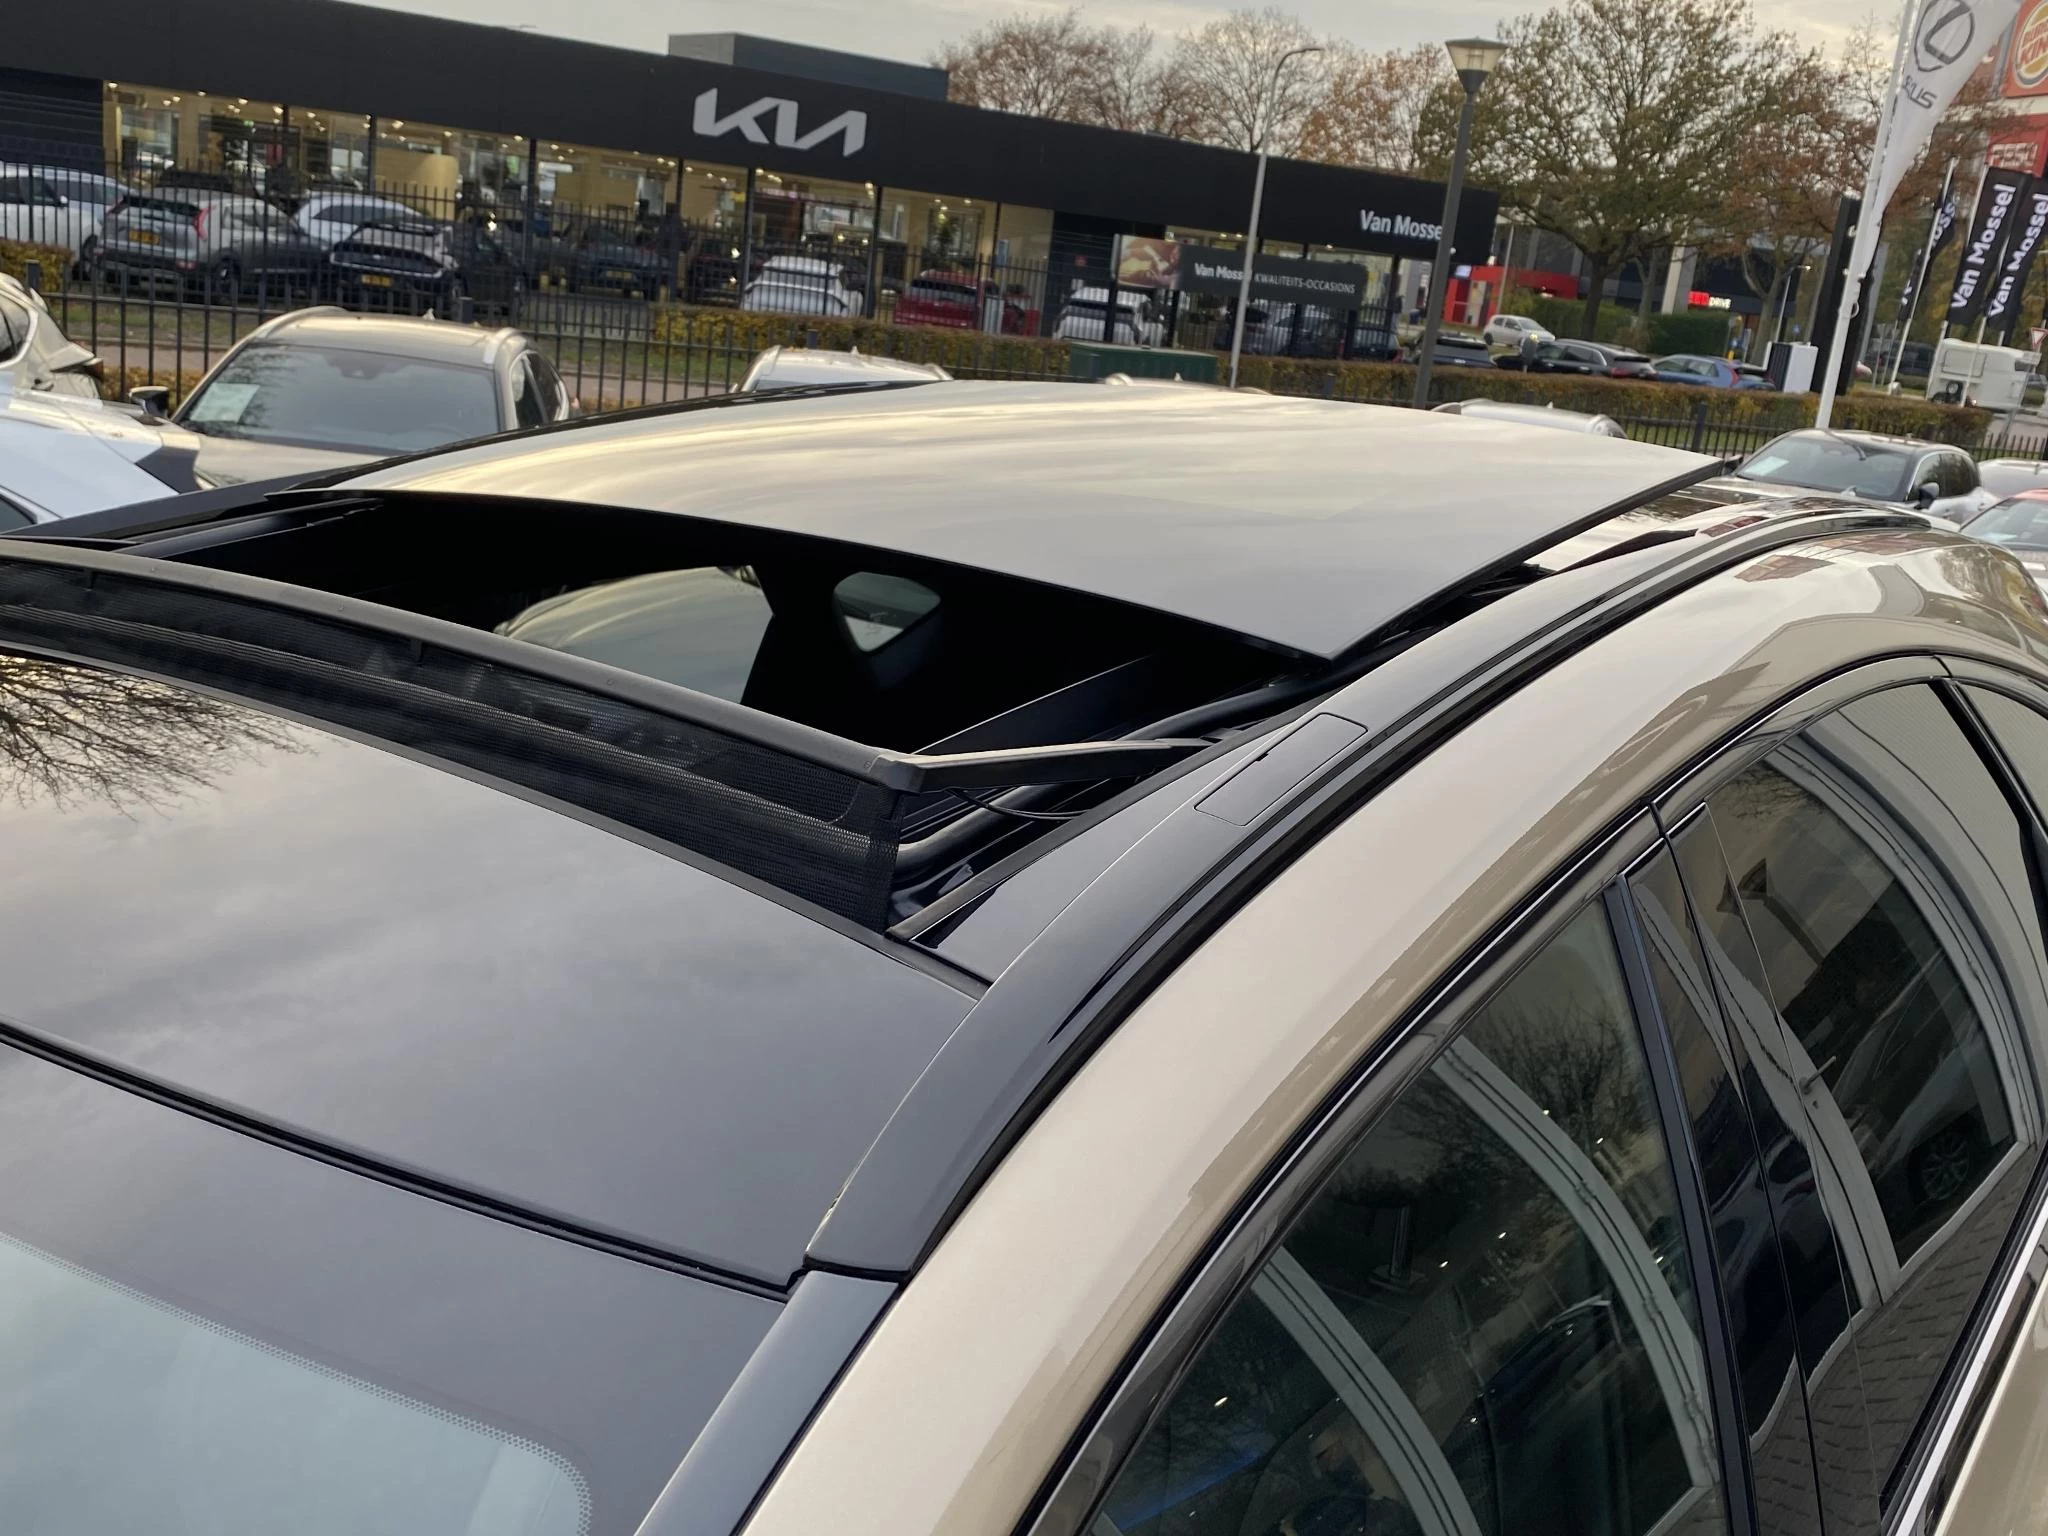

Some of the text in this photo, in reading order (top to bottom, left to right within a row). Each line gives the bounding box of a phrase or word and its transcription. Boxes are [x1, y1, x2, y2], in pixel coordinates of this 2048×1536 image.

[693, 87, 867, 156] KIA
[1360, 208, 1443, 240] Van Mosse
[1951, 269, 1980, 308] Van
[1967, 184, 2016, 265] Mossel
[1988, 275, 2015, 317] Van
[2007, 193, 2048, 271] Mossel
[1194, 262, 1355, 295] Van Moss KWALITEITS-OCCASIONS
